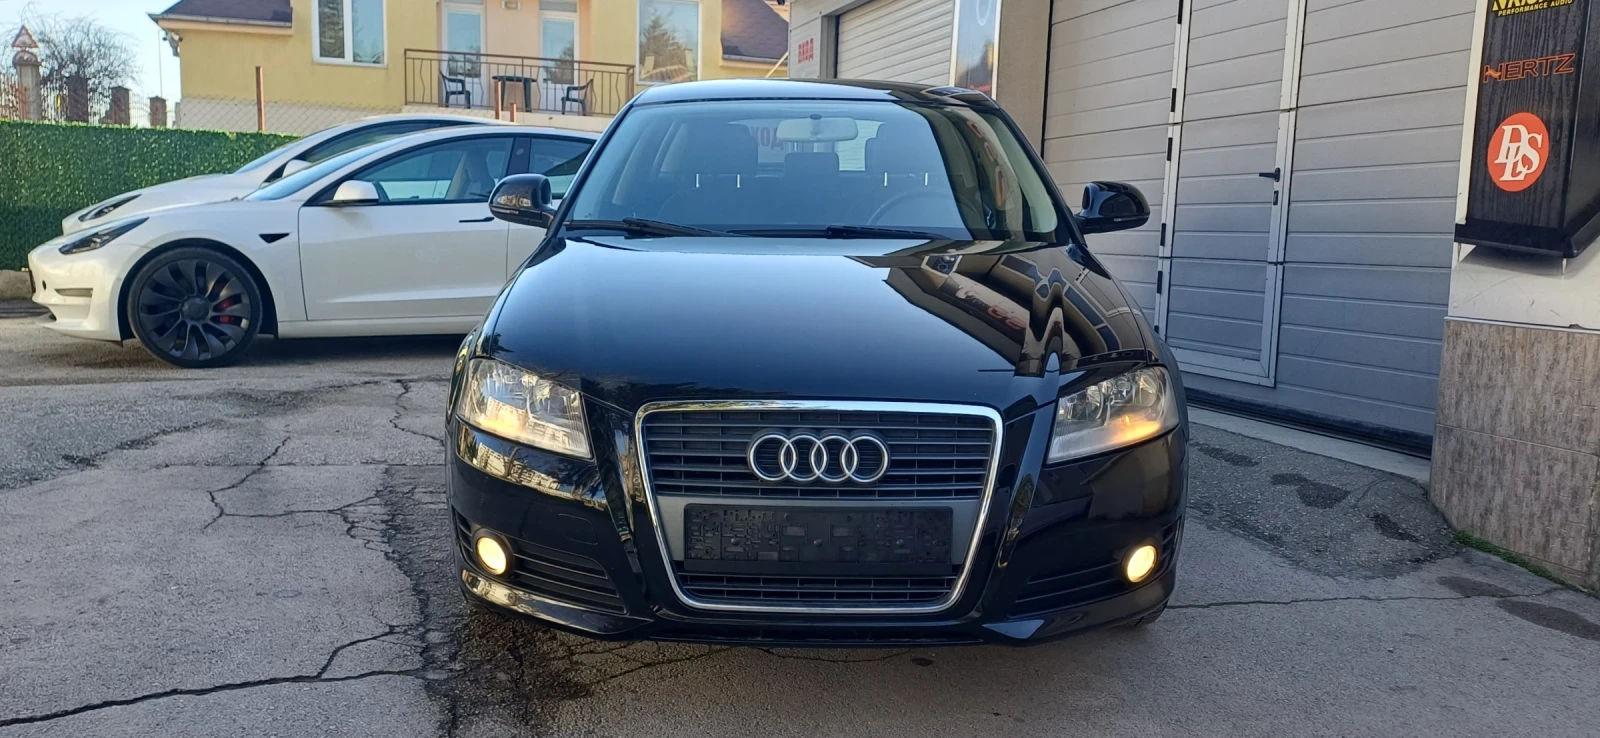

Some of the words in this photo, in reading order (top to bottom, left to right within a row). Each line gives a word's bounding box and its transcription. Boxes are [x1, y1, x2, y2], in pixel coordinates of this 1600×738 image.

[1498, 2, 1548, 16] PERFORMANCE
[1483, 53, 1576, 83] HERTZ
[1494, 124, 1543, 181] DLS
